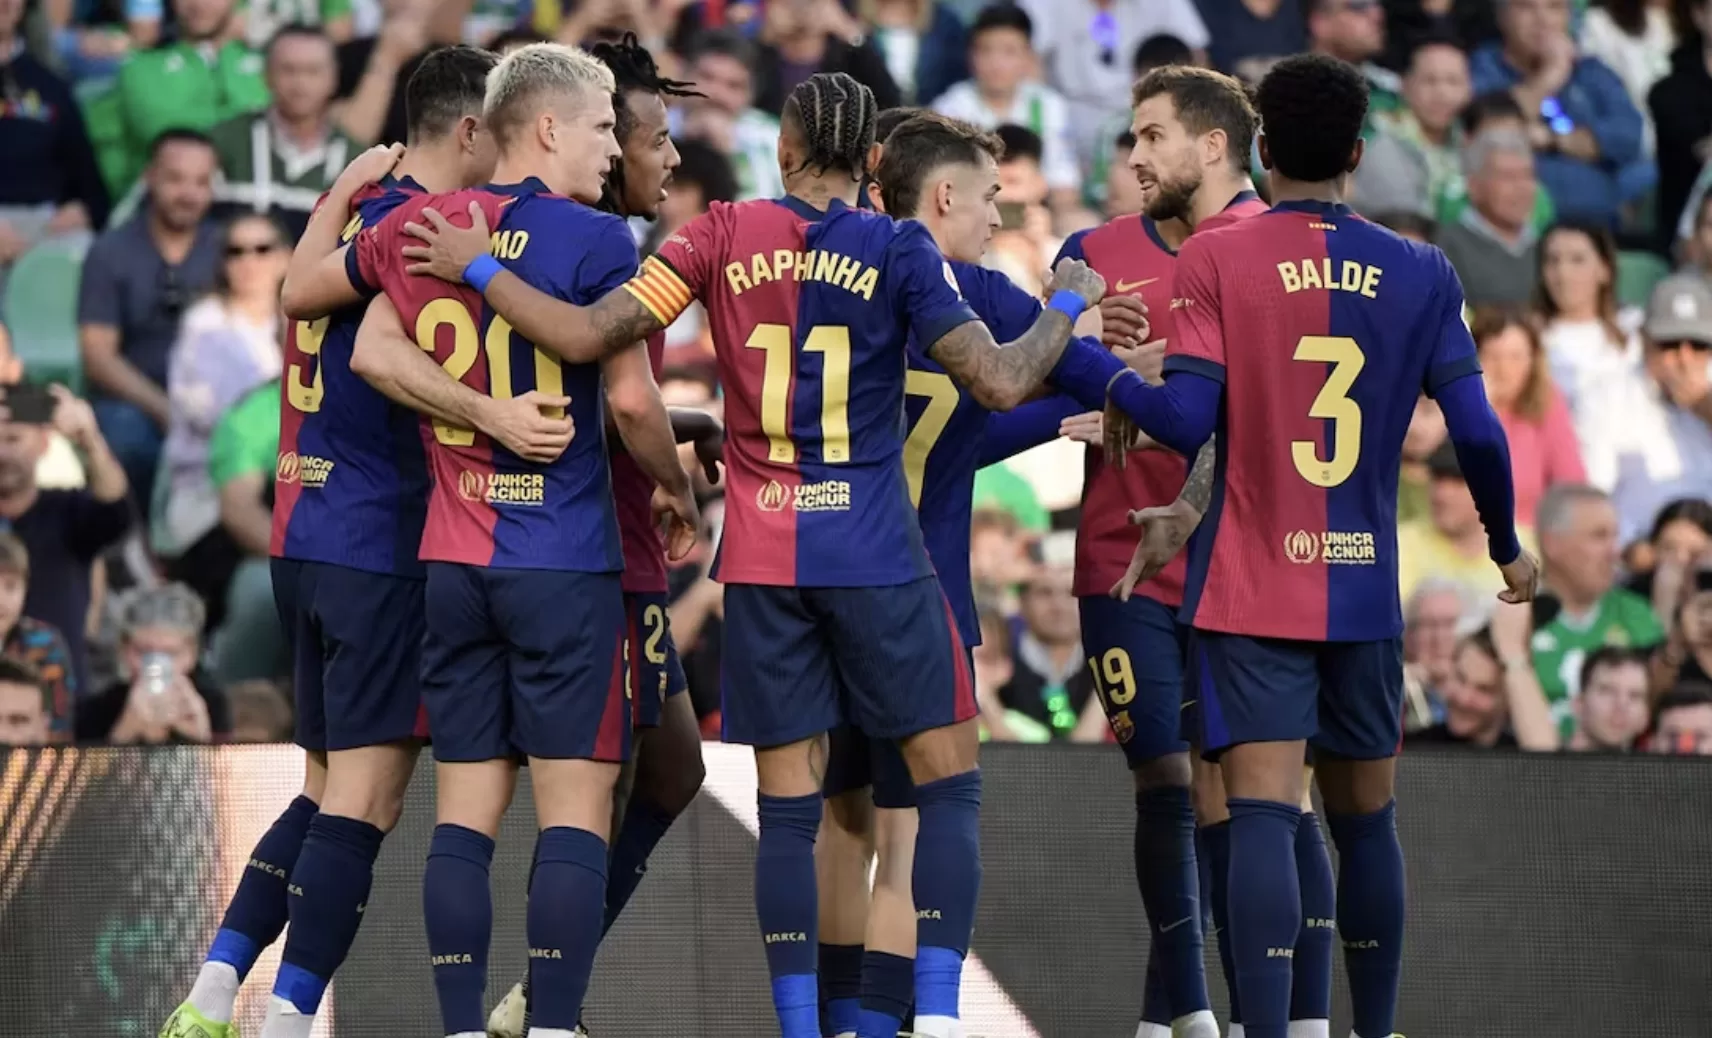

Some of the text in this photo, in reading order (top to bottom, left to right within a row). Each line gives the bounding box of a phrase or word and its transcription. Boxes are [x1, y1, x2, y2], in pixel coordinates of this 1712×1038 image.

[725, 249, 879, 301] RAPHINHA
[1277, 257, 1382, 299] BALDE
[416, 297, 564, 446] 20
[745, 323, 852, 463] 11
[1290, 336, 1366, 487] 3
[485, 487, 544, 501] ACNUR
[488, 473, 544, 488] UNHCR
[794, 480, 851, 496] UNHCR
[792, 494, 851, 507] ACNUR
[1321, 531, 1374, 545] UNHCR
[1321, 546, 1375, 559] ACNUR
[1088, 646, 1137, 714] 19
